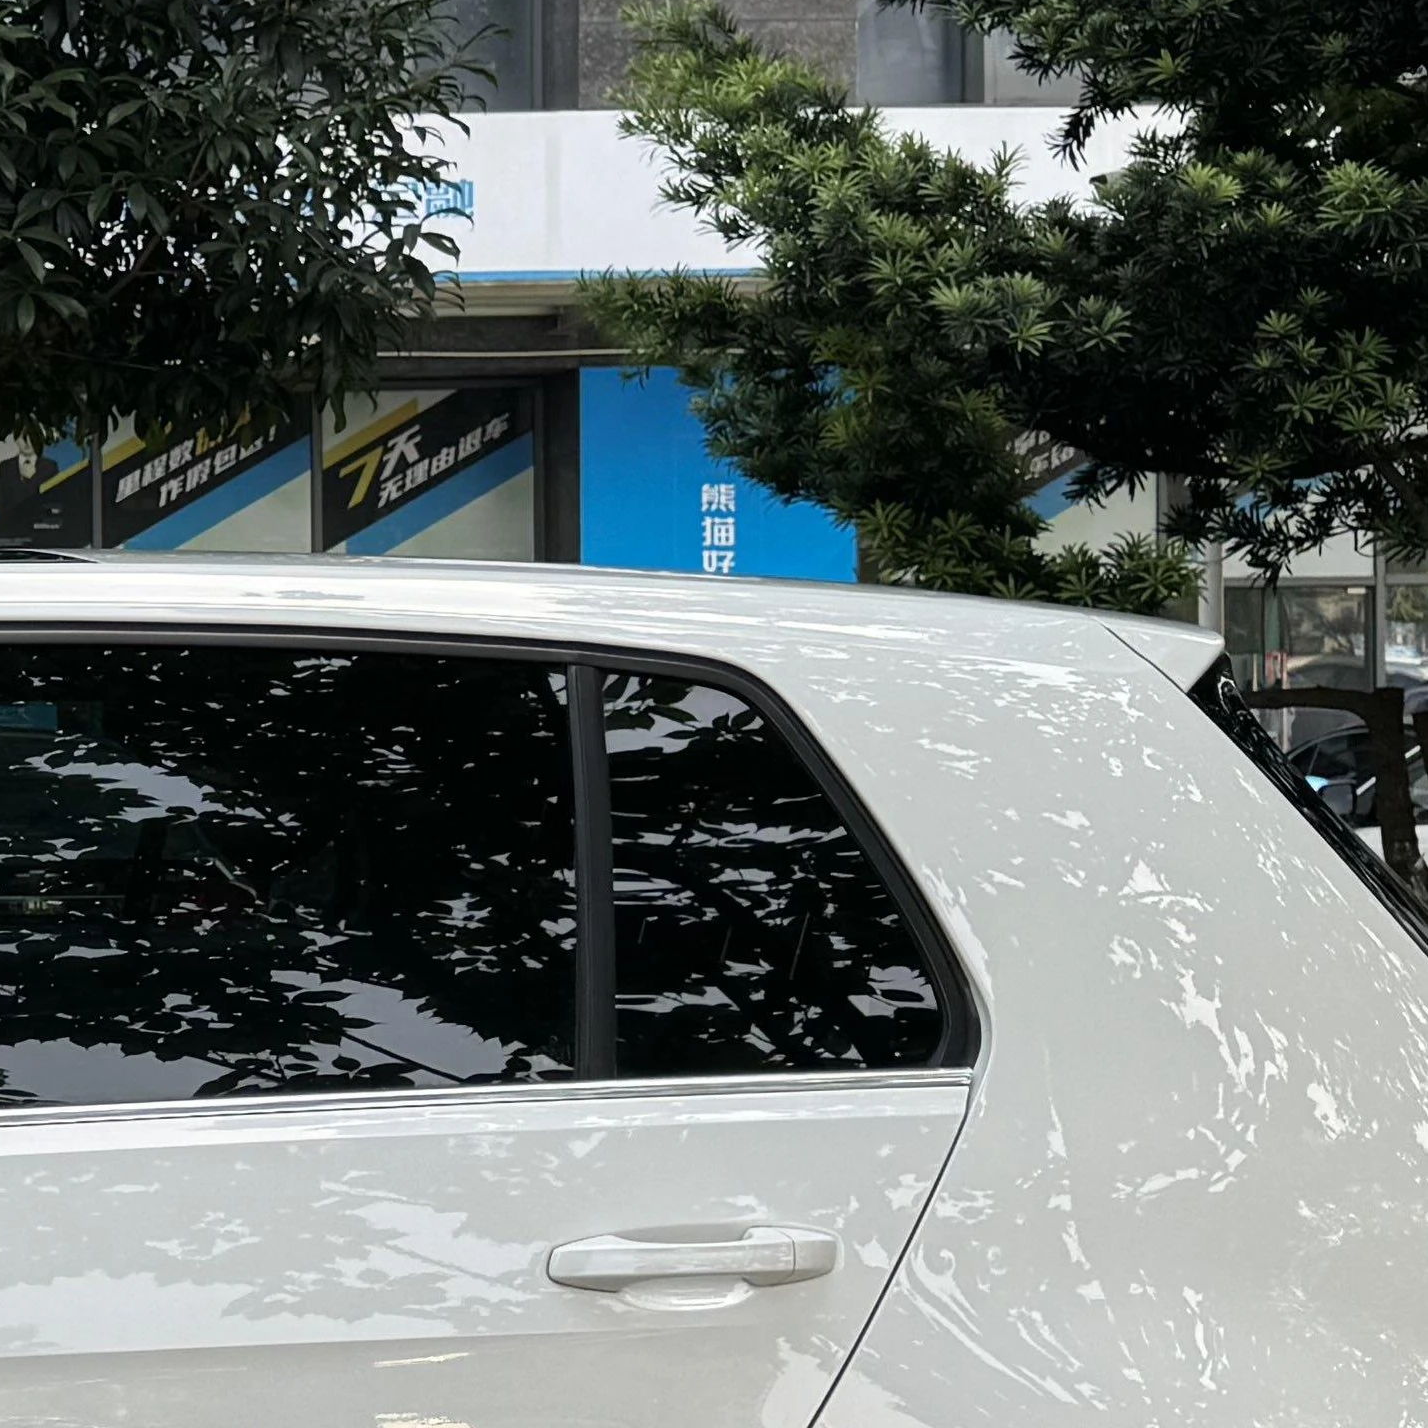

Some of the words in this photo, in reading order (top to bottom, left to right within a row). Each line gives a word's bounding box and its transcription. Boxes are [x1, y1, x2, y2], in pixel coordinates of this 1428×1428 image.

[338, 423, 423, 510] 7天
[377, 412, 511, 509] 无理由退车
